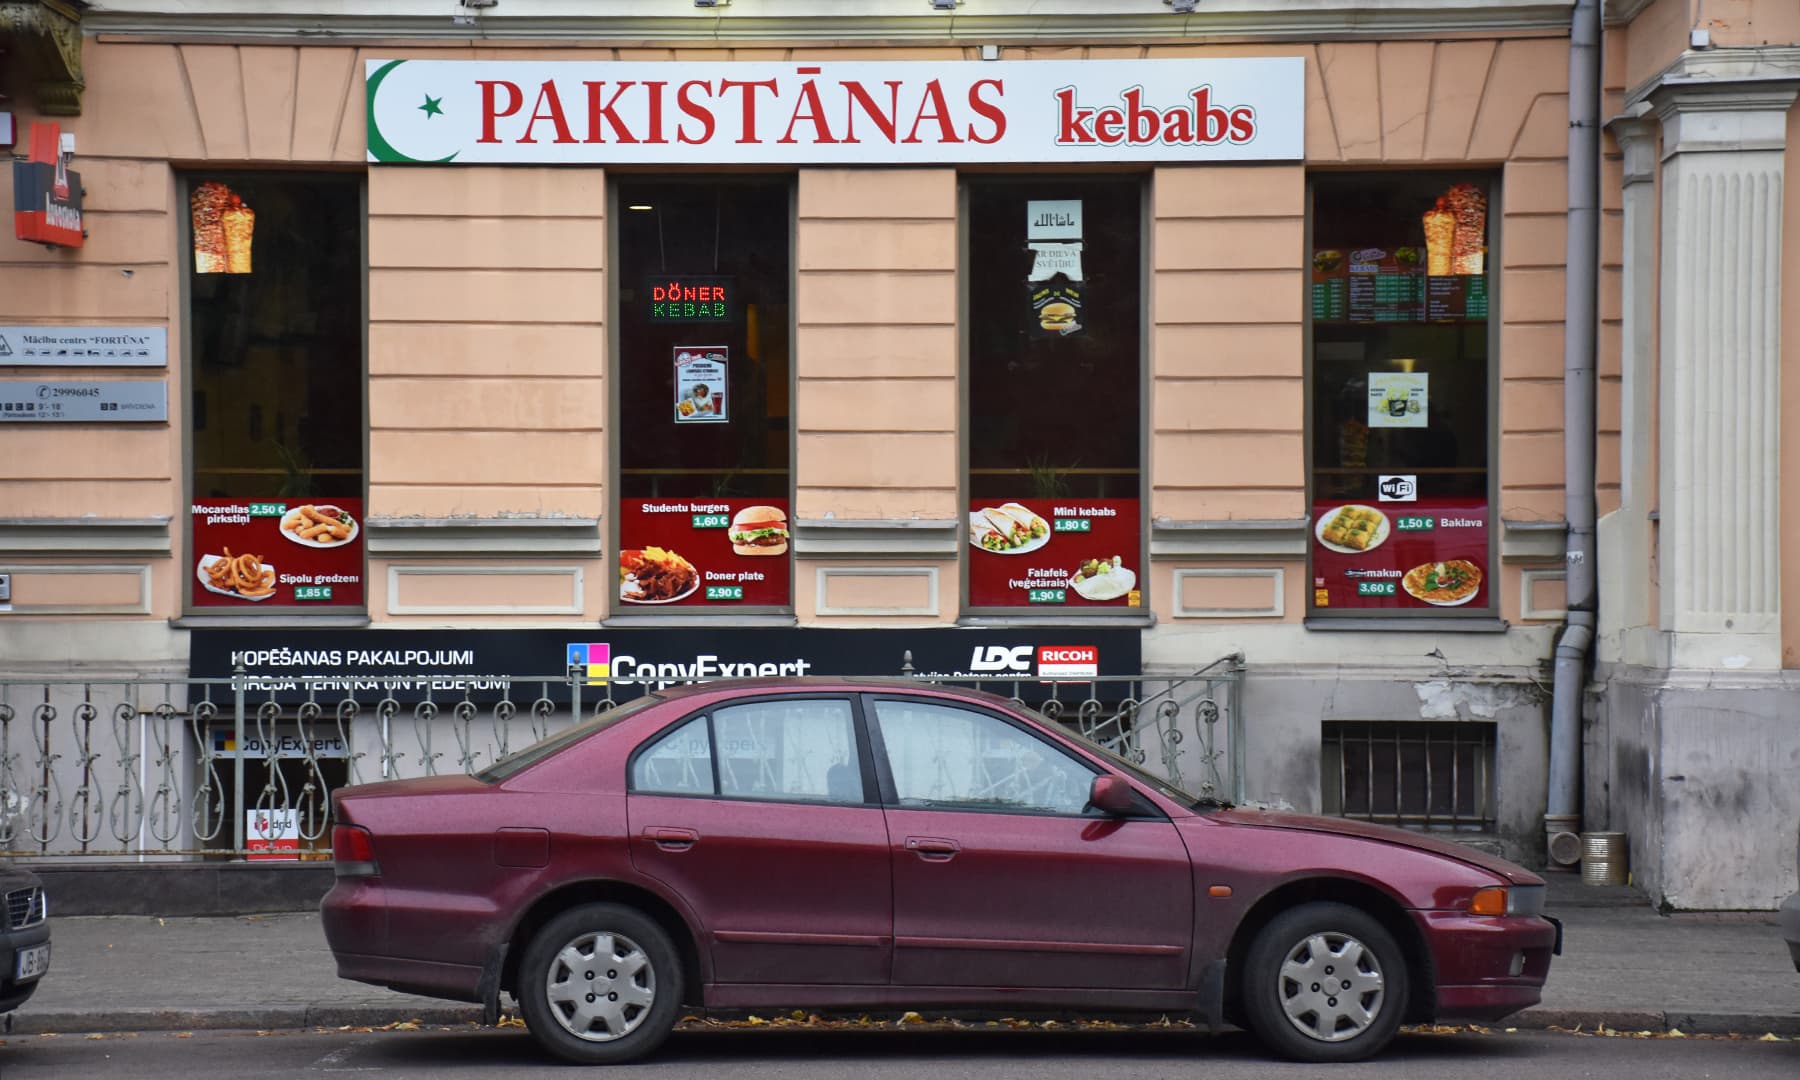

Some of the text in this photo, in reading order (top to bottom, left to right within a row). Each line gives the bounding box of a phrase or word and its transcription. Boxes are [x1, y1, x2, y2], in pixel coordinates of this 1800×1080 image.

[474, 66, 1255, 145] PAKISTĀNAS kebabs
[653, 282, 725, 301] DÖNER
[654, 303, 725, 317] KEBAB
[23, 335, 57, 344] Mācību
[59, 336, 87, 345] centrs
[52, 387, 100, 397] 29996045
[191, 505, 286, 515] Mocarellas 2,50 €
[642, 503, 730, 514] Studentu burgers
[1053, 507, 1117, 516] Mini kebabs
[207, 514, 250, 526] pirkstiņi
[694, 517, 729, 527] 1,60 €
[1054, 520, 1089, 530] 1,80 €
[1398, 518, 1483, 529] 1,50 € Baklava
[705, 571, 765, 582] Doner plate
[1027, 568, 1068, 578] Falafels
[279, 573, 359, 585] Sīpolu gredzeni
[296, 588, 331, 598] 1,85 €
[708, 588, 742, 598] 2,90 €
[1360, 583, 1395, 593] 3,60 €
[1029, 591, 1065, 601] 1,90 €
[231, 646, 474, 666] KOPĒŠANAS PAKALPOJUMI
[969, 645, 1034, 671] LDC
[1041, 650, 1094, 662] RICOH
[303, 675, 380, 691] TEHNKA
